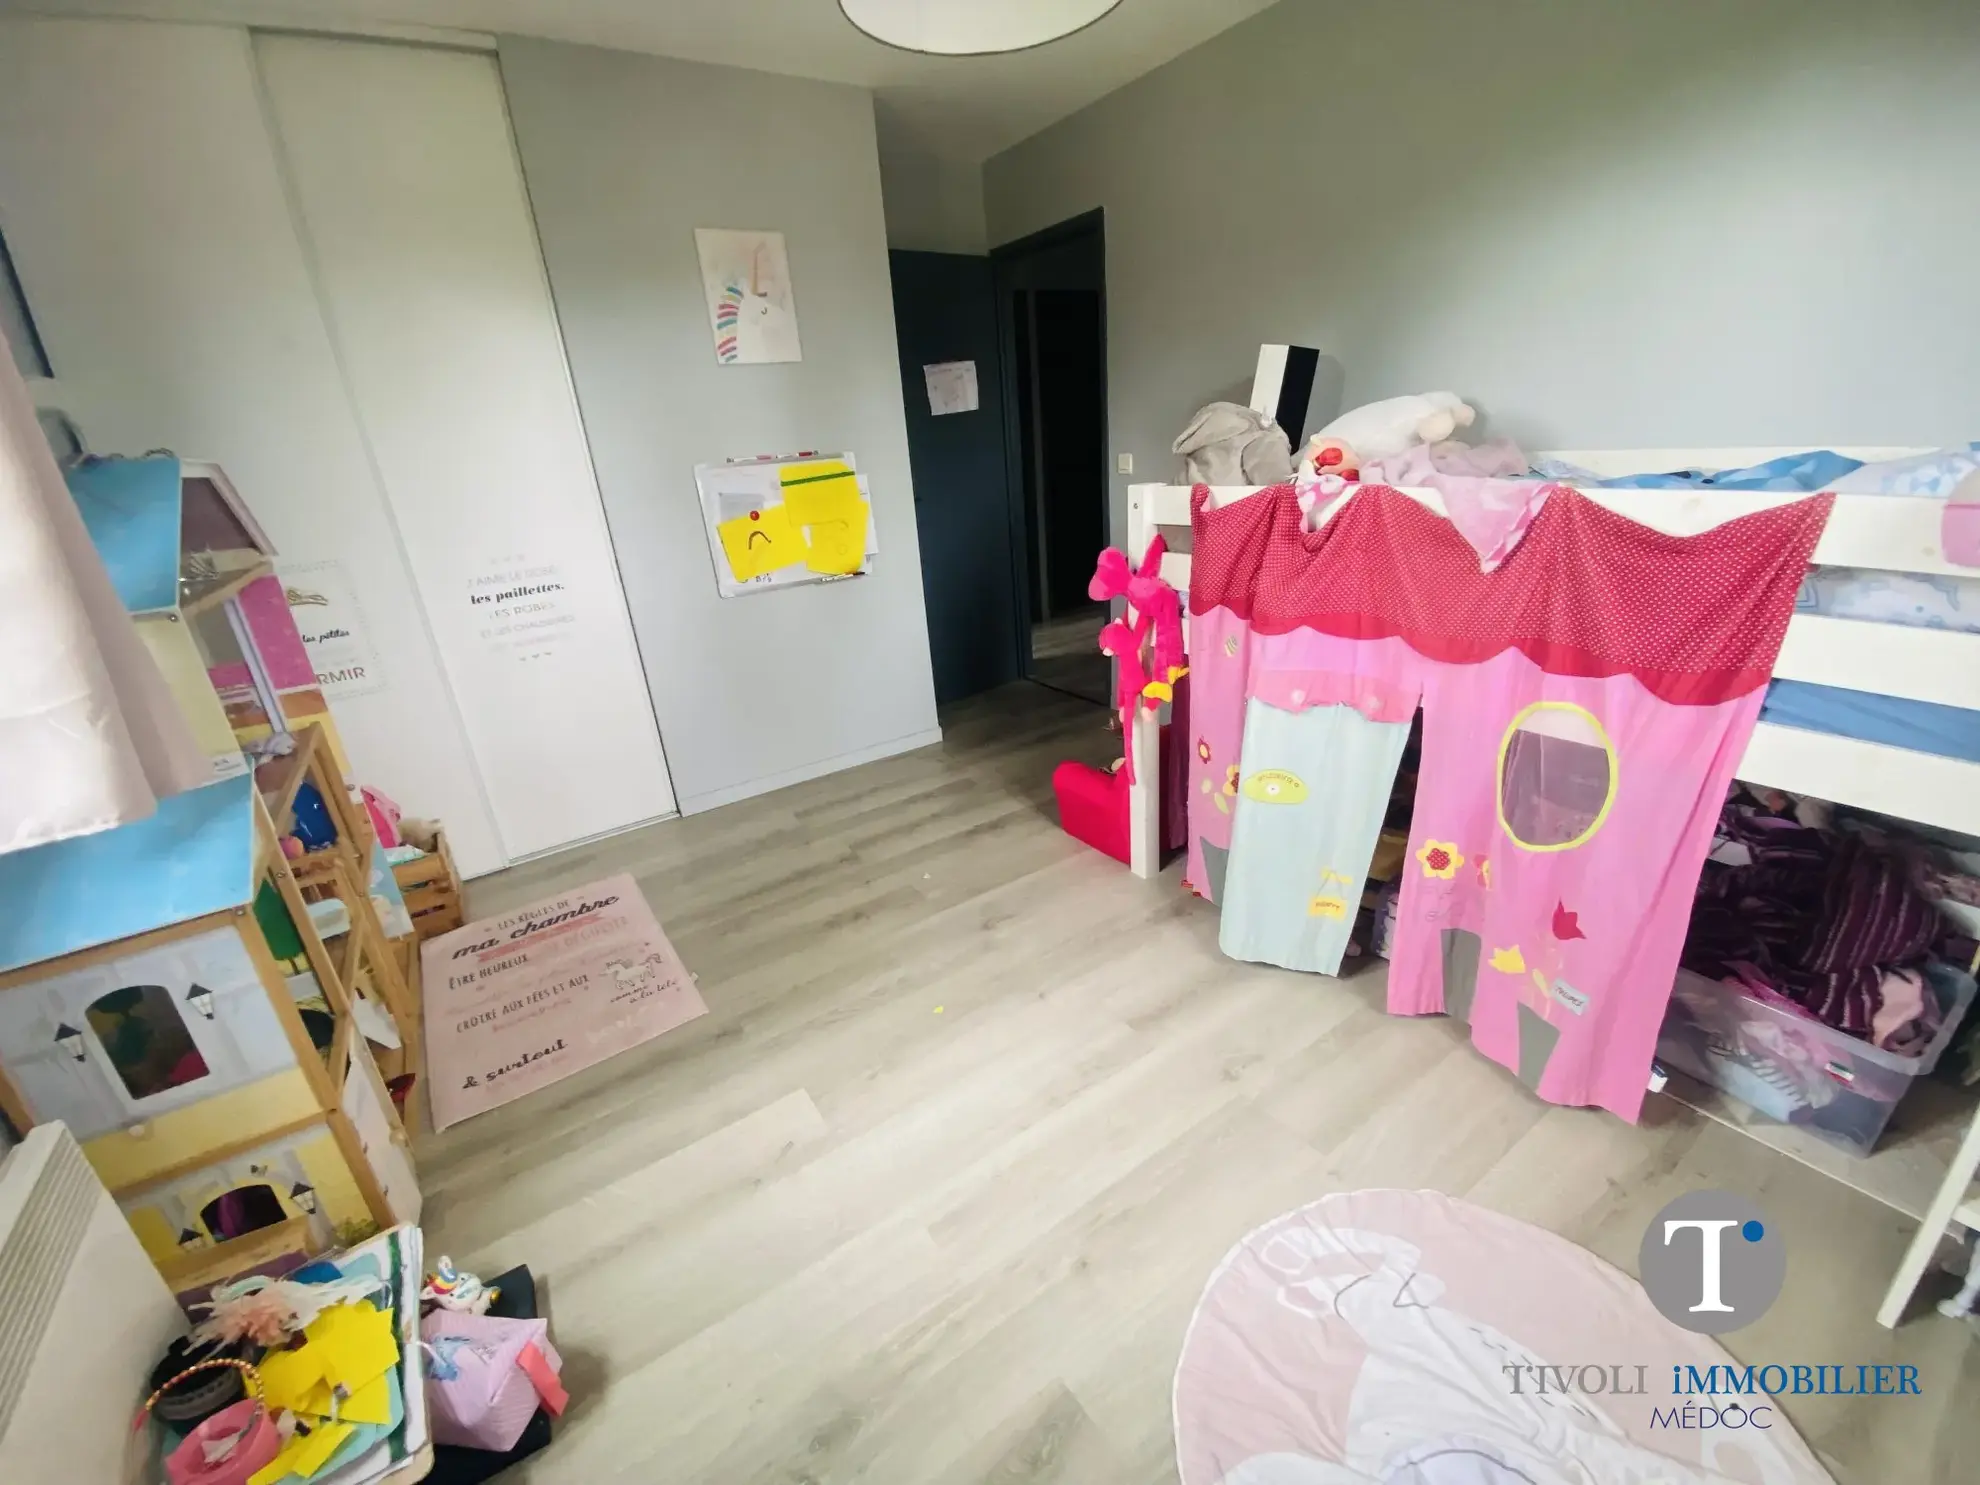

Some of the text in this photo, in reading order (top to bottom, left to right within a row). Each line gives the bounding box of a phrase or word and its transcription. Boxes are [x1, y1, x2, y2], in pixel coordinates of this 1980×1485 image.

[470, 582, 565, 605] les paillettes.
[316, 666, 366, 685] RMIR
[452, 895, 620, 960] ma chambre
[479, 953, 529, 979] HEUREUX
[502, 999, 524, 1016] AUX
[552, 981, 566, 996] ET
[568, 973, 590, 989] AUX
[462, 1075, 480, 1090] &
[485, 1039, 569, 1083] surtout
